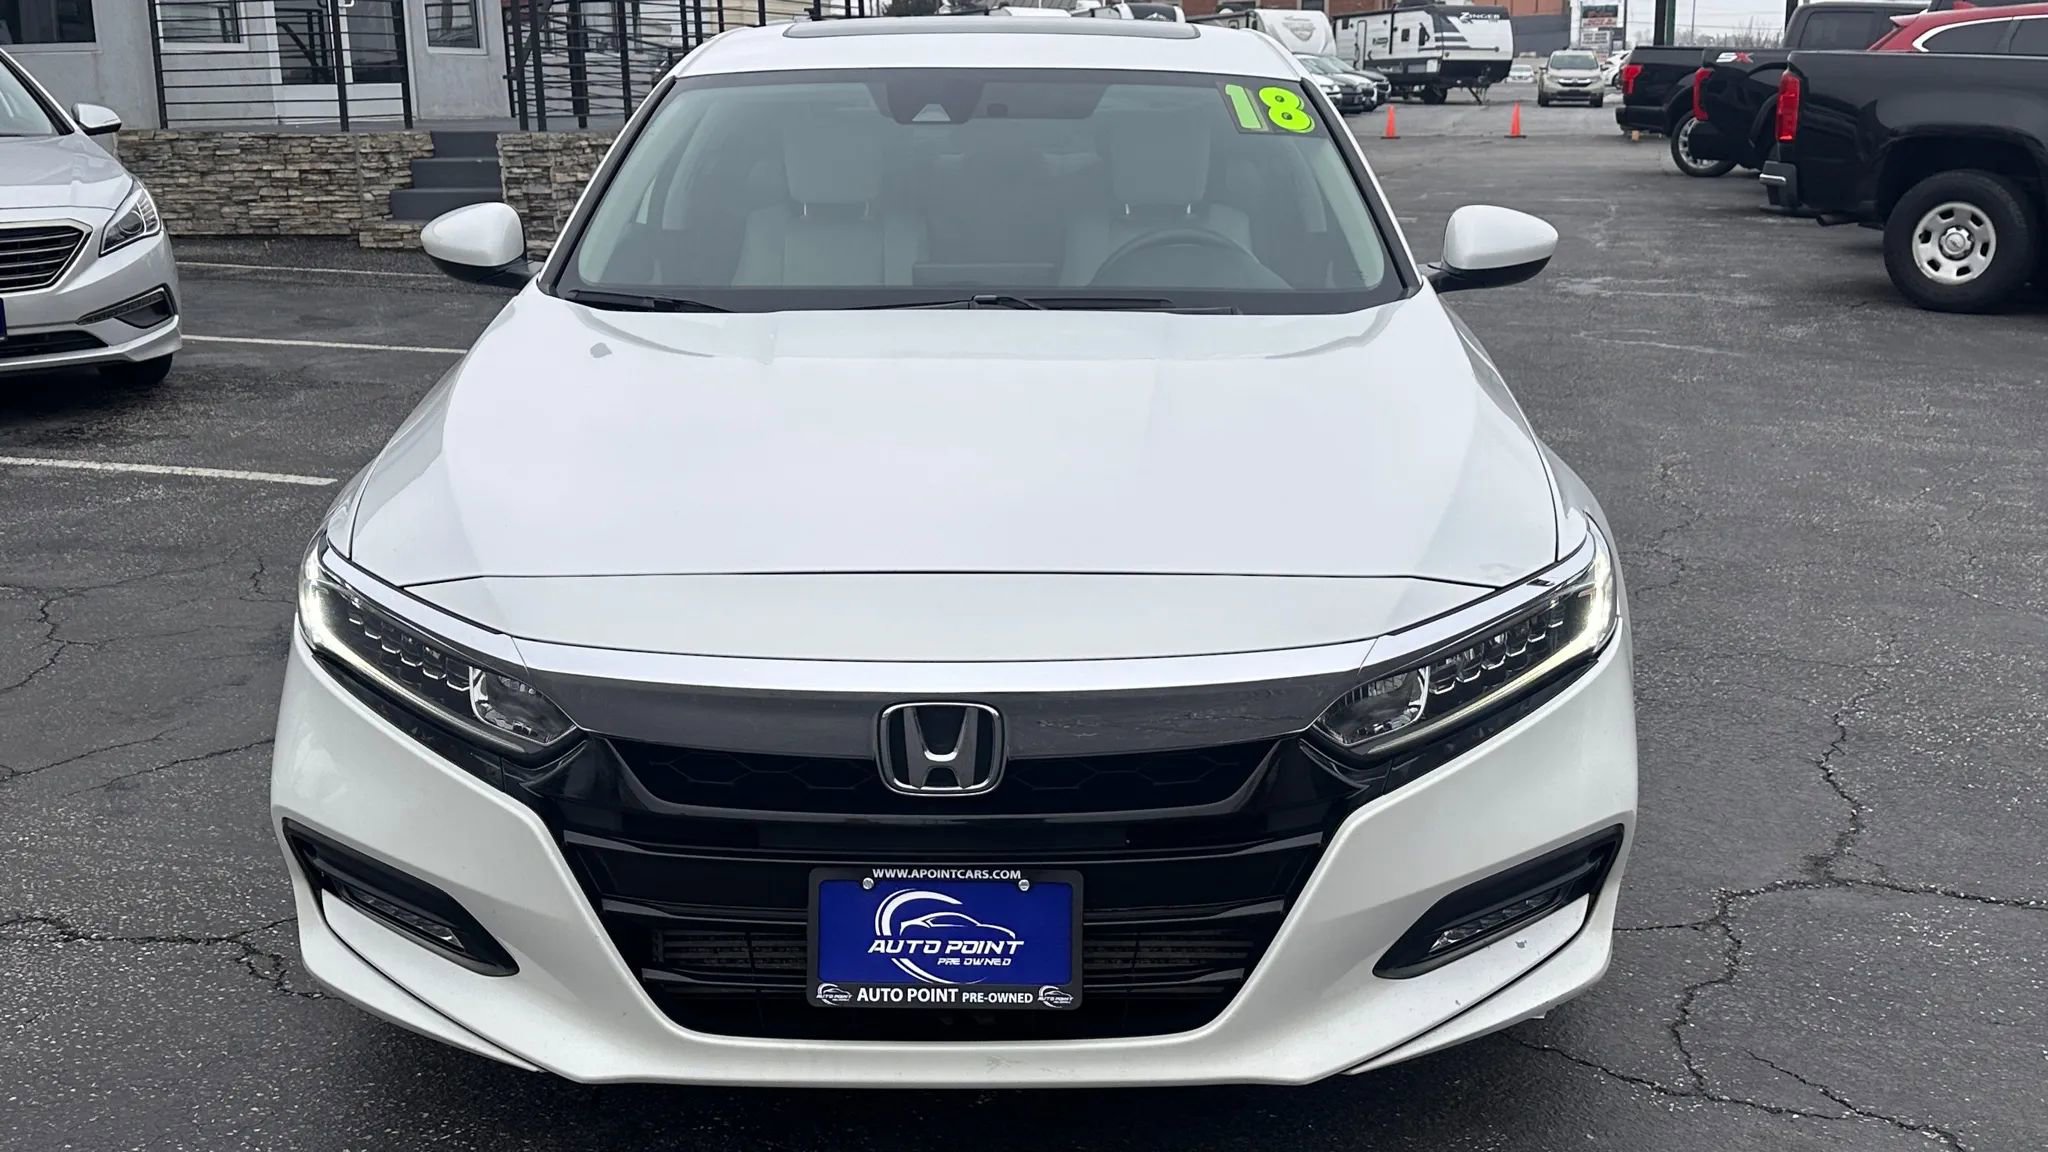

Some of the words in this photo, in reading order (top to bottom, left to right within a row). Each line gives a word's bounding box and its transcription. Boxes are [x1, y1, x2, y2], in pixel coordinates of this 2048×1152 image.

[1225, 84, 1315, 133] 18
[872, 868, 1021, 880] WWW.APOINTCARS.COM
[867, 939, 942, 954] AUTO
[944, 940, 1025, 955] POINT
[937, 957, 960, 966] PRE
[963, 957, 1012, 966] OWNED
[856, 987, 903, 1003] AUTO
[907, 988, 959, 1003] POINT
[962, 992, 1033, 1004] PRE-OWNED
